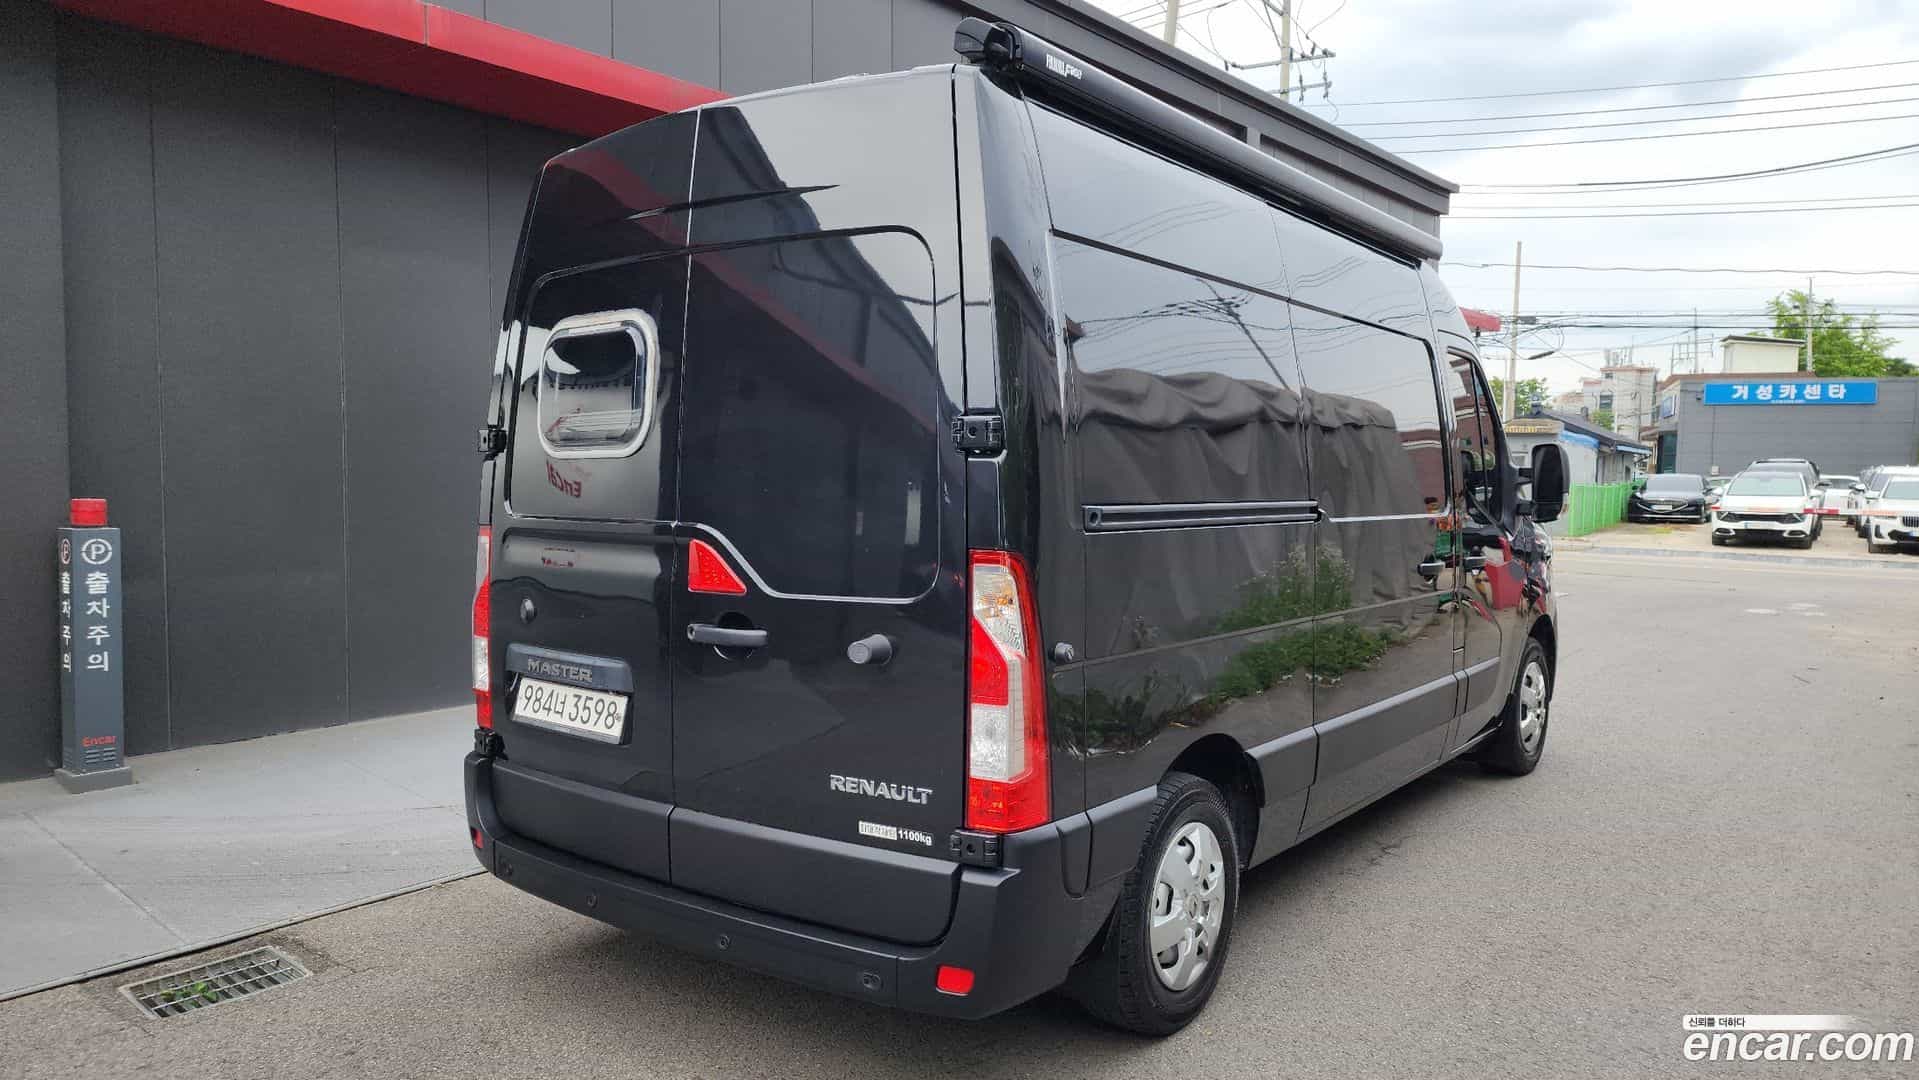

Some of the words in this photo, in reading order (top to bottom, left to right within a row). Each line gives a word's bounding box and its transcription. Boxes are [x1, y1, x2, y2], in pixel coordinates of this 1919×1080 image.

[527, 658, 593, 682] MASTER
[568, 694, 618, 730] 3598
[830, 774, 933, 805] RENAULT
[898, 828, 933, 846] 1100kg
